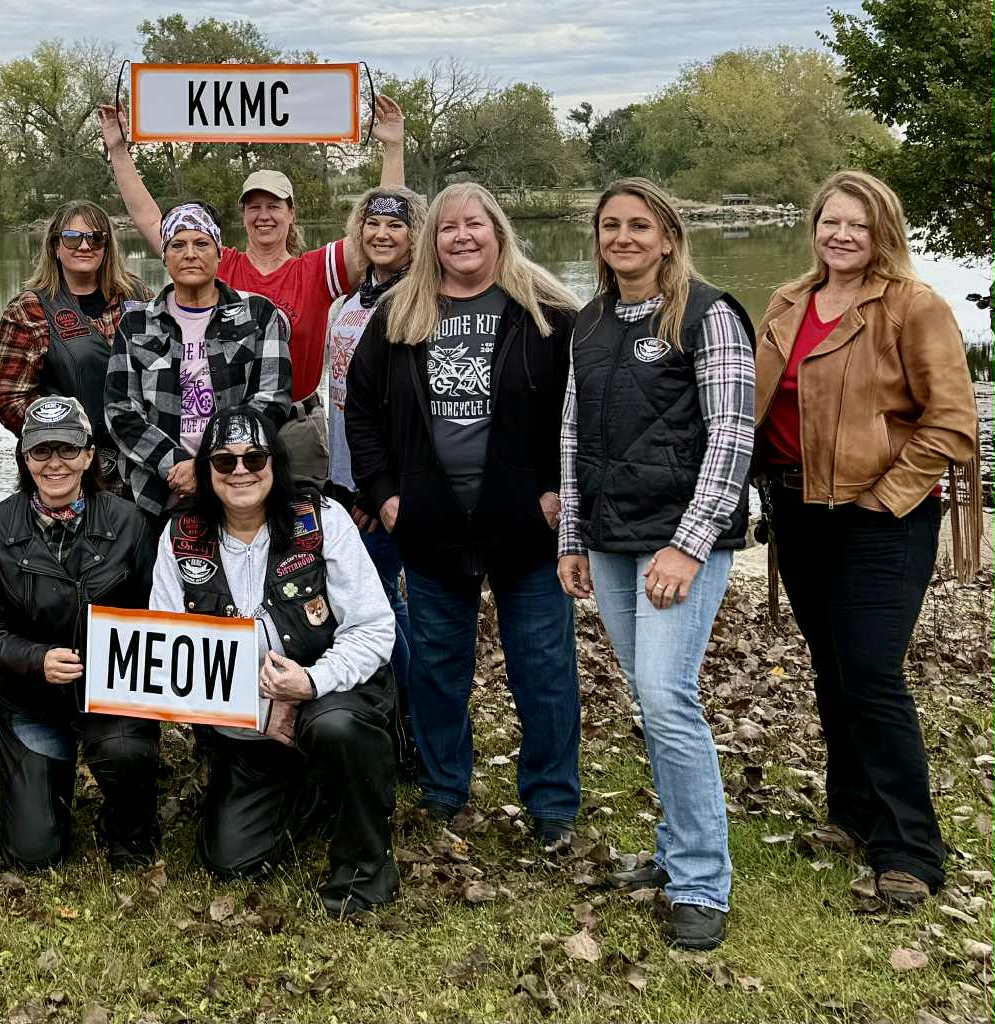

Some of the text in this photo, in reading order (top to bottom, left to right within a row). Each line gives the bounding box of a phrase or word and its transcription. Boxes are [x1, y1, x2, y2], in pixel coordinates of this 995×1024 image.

[188, 80, 289, 127] KKMC
[430, 400, 483, 417] OTORCYCLE
[107, 627, 238, 702] MEOW
